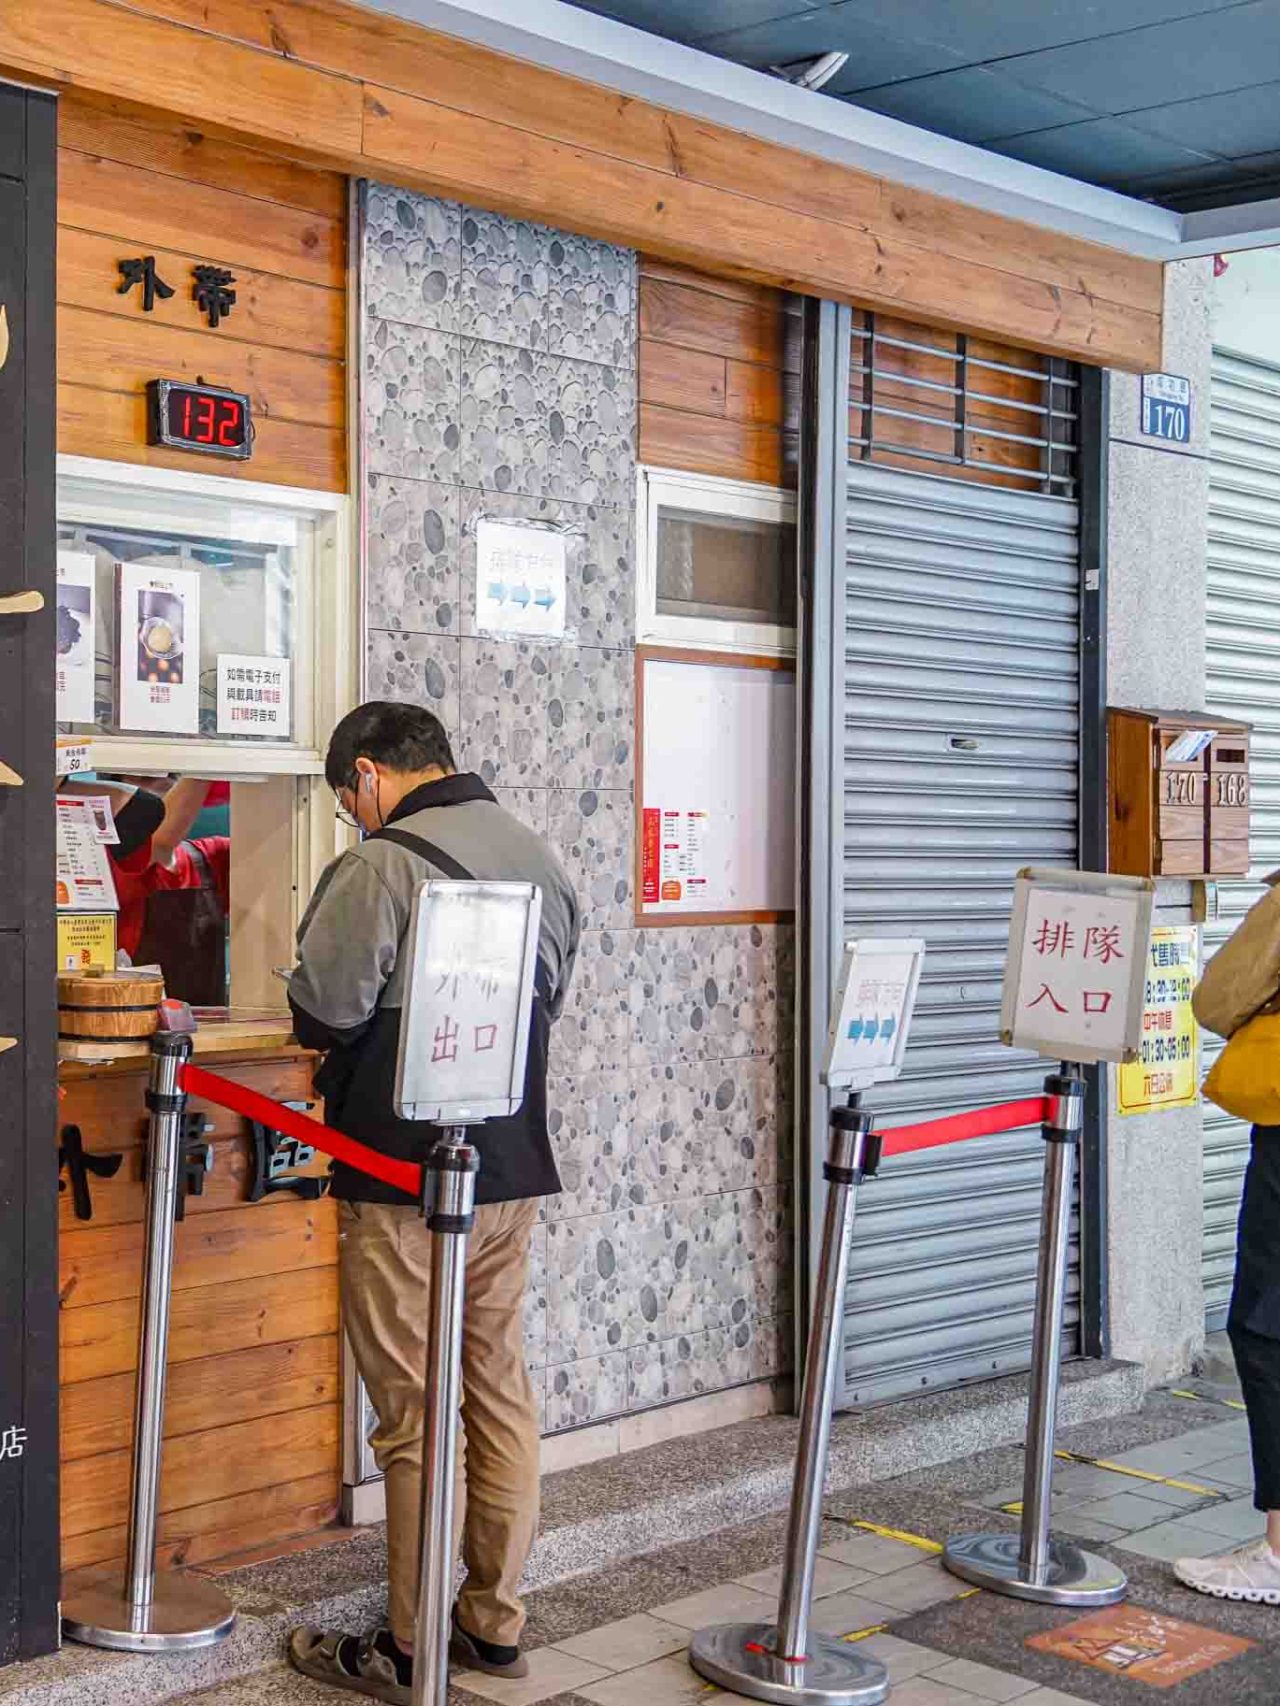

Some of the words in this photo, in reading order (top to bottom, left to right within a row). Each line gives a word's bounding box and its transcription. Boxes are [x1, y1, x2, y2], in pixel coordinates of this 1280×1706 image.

[116, 255, 236, 328] 外帶
[181, 394, 239, 447] 132
[1155, 404, 1185, 441] 170
[1166, 771, 1197, 804] 170
[1217, 772, 1248, 806] 168
[1032, 918, 1125, 965] 排隊
[1026, 983, 1113, 1014] 入口
[431, 1014, 498, 1063] 出口
